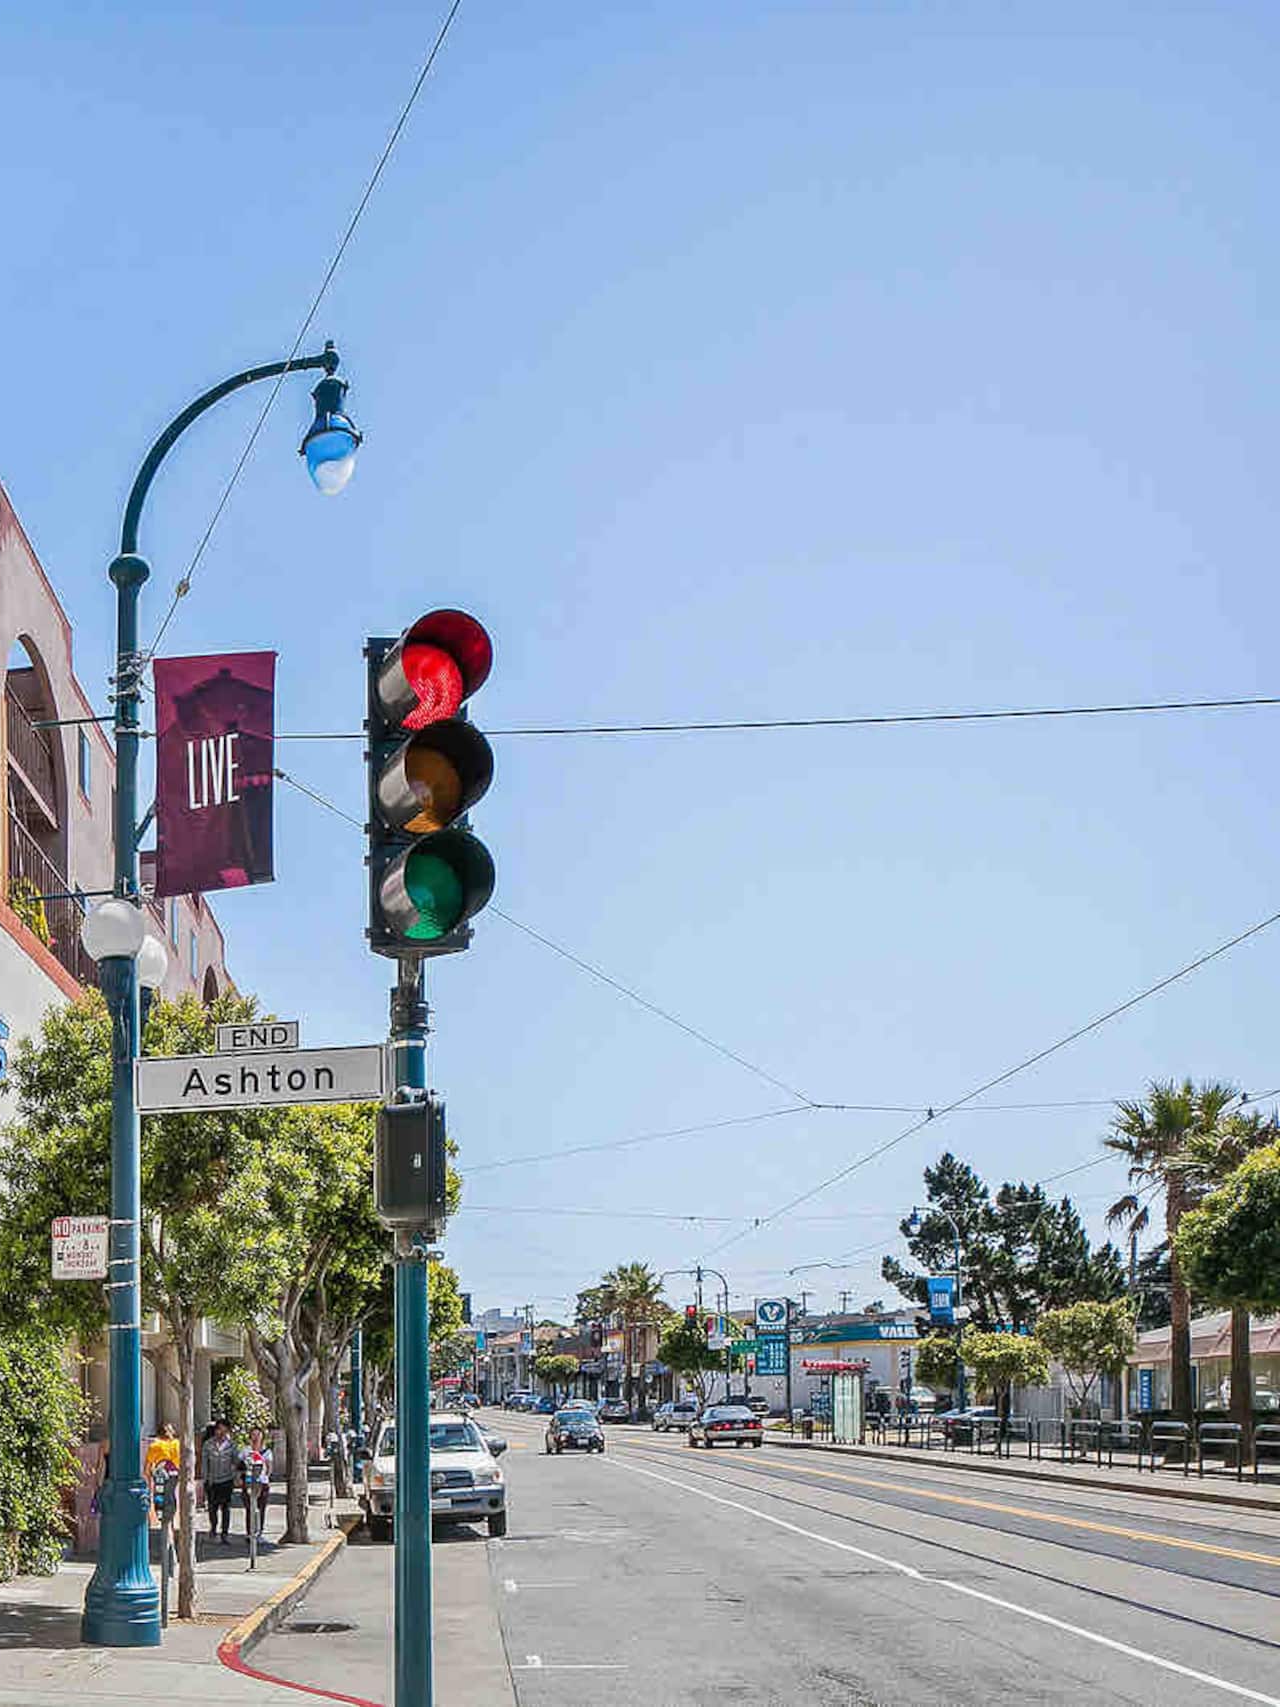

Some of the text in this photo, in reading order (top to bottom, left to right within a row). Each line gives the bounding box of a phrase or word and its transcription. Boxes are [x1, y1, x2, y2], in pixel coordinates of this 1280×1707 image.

[187, 732, 241, 810] LIVE
[232, 1026, 289, 1048] END
[182, 1064, 335, 1097] Ashton
[53, 1220, 69, 1236] NO
